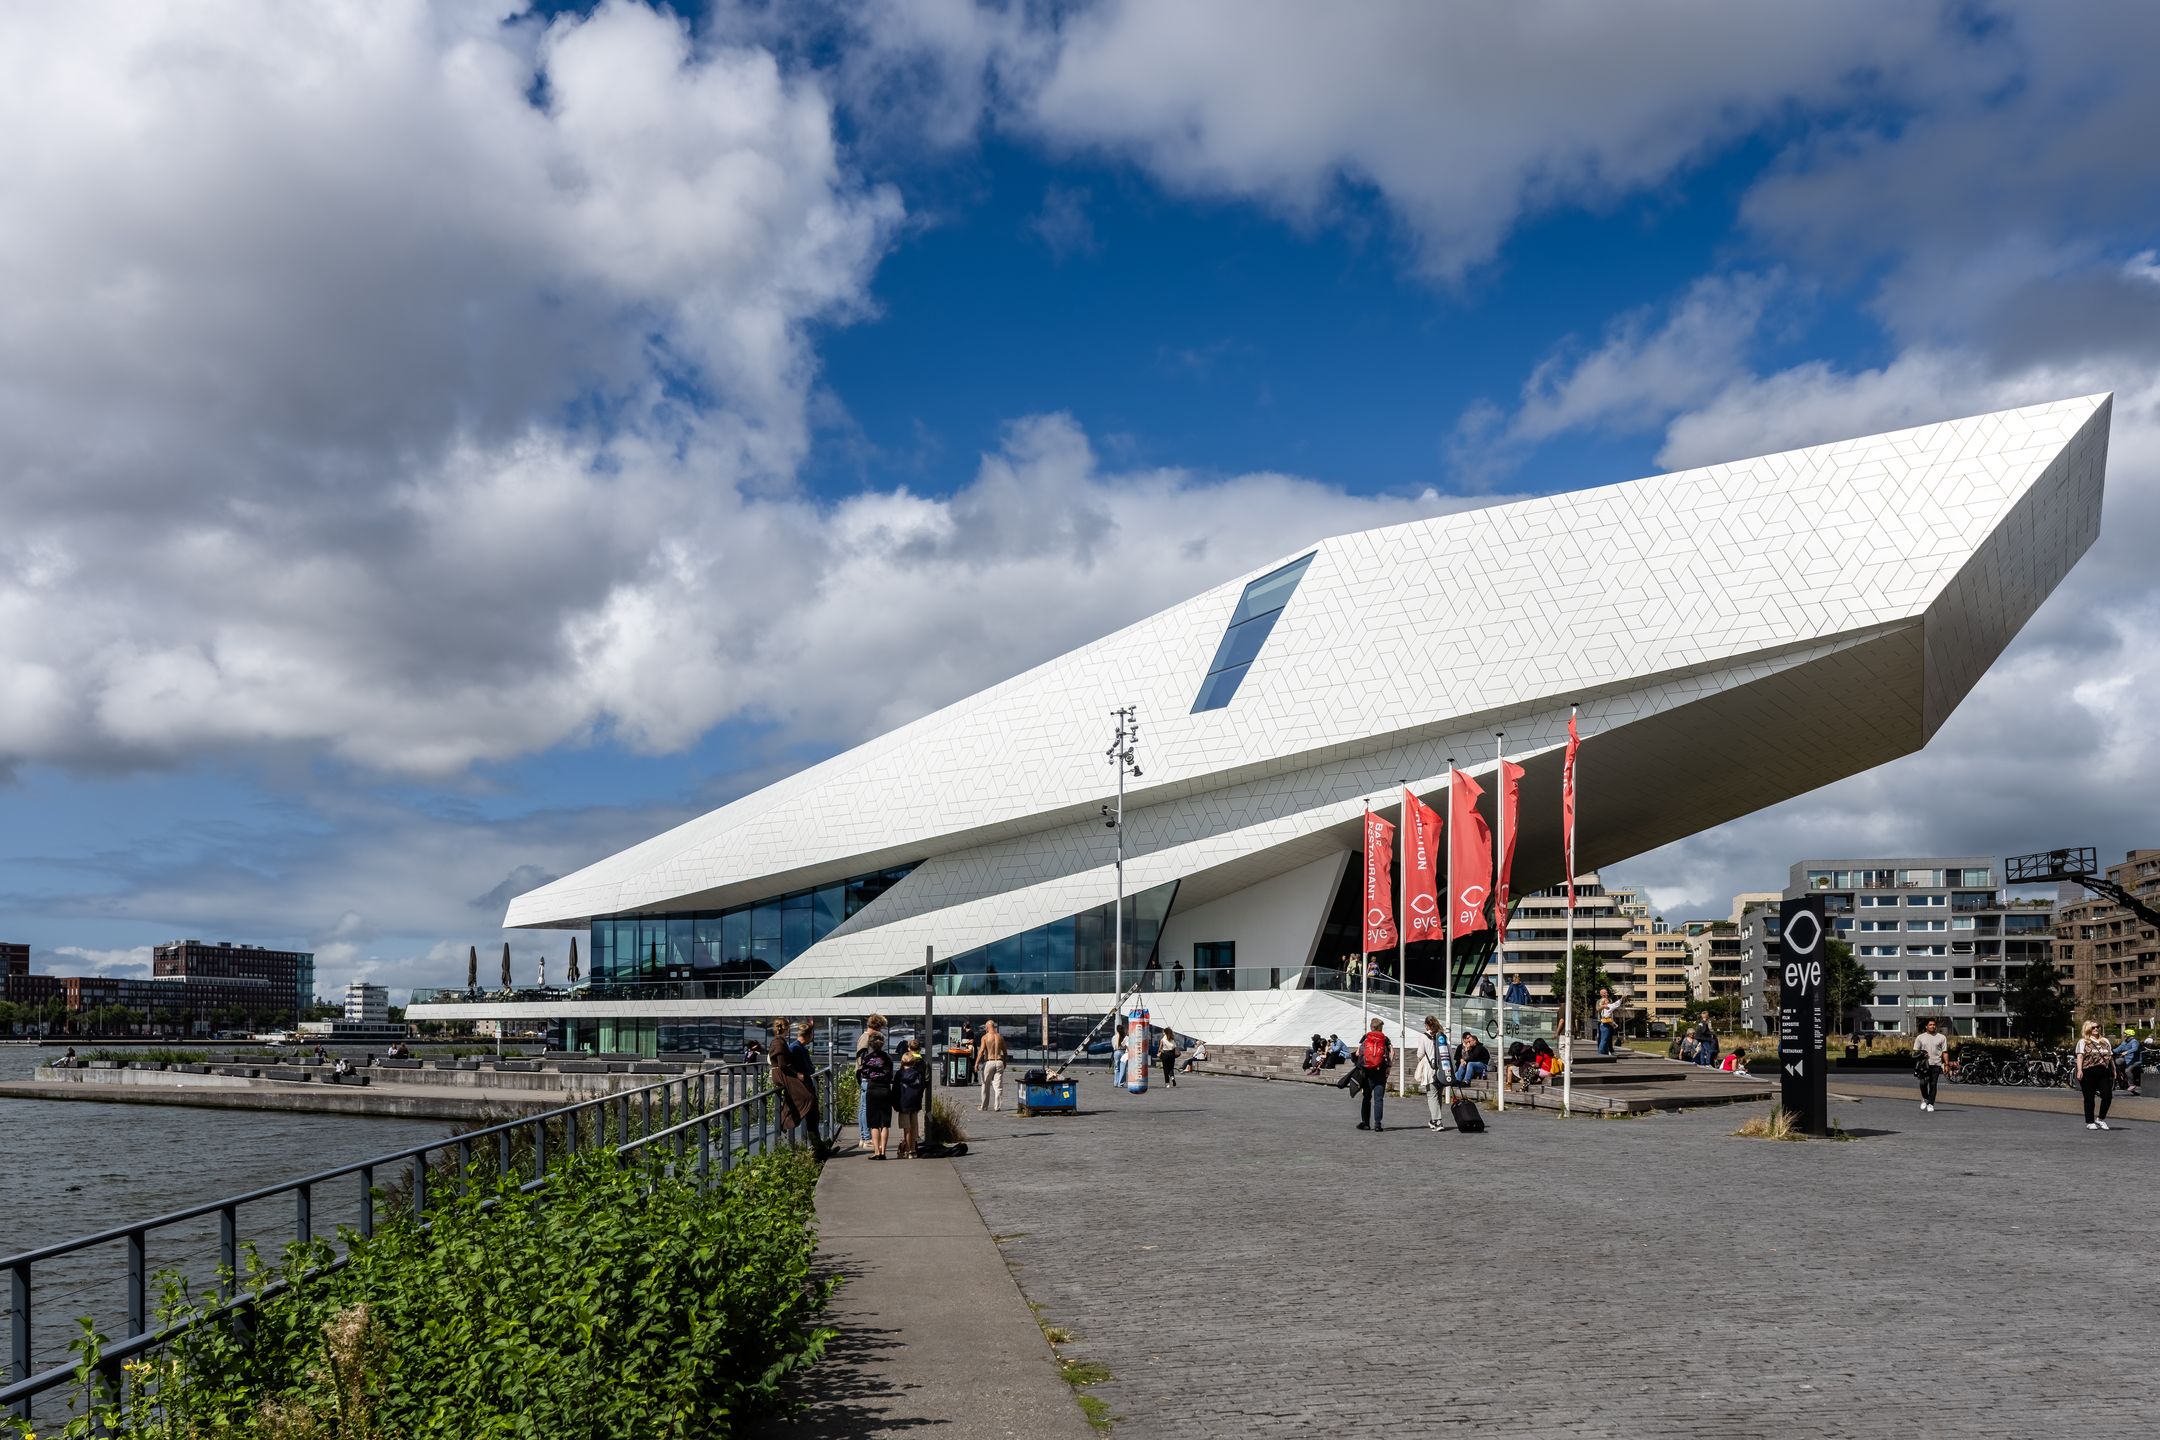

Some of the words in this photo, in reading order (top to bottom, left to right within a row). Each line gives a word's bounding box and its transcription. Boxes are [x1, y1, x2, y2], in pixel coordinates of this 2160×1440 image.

[1375, 823, 1383, 846] BAR
[1367, 821, 1377, 900] RESTAURANT
[1413, 916, 1438, 932] eye
[1460, 909, 1477, 926] ey
[1367, 928, 1388, 943] eye
[1785, 961, 1821, 996] eye
[1505, 1022, 1520, 1038] eye
